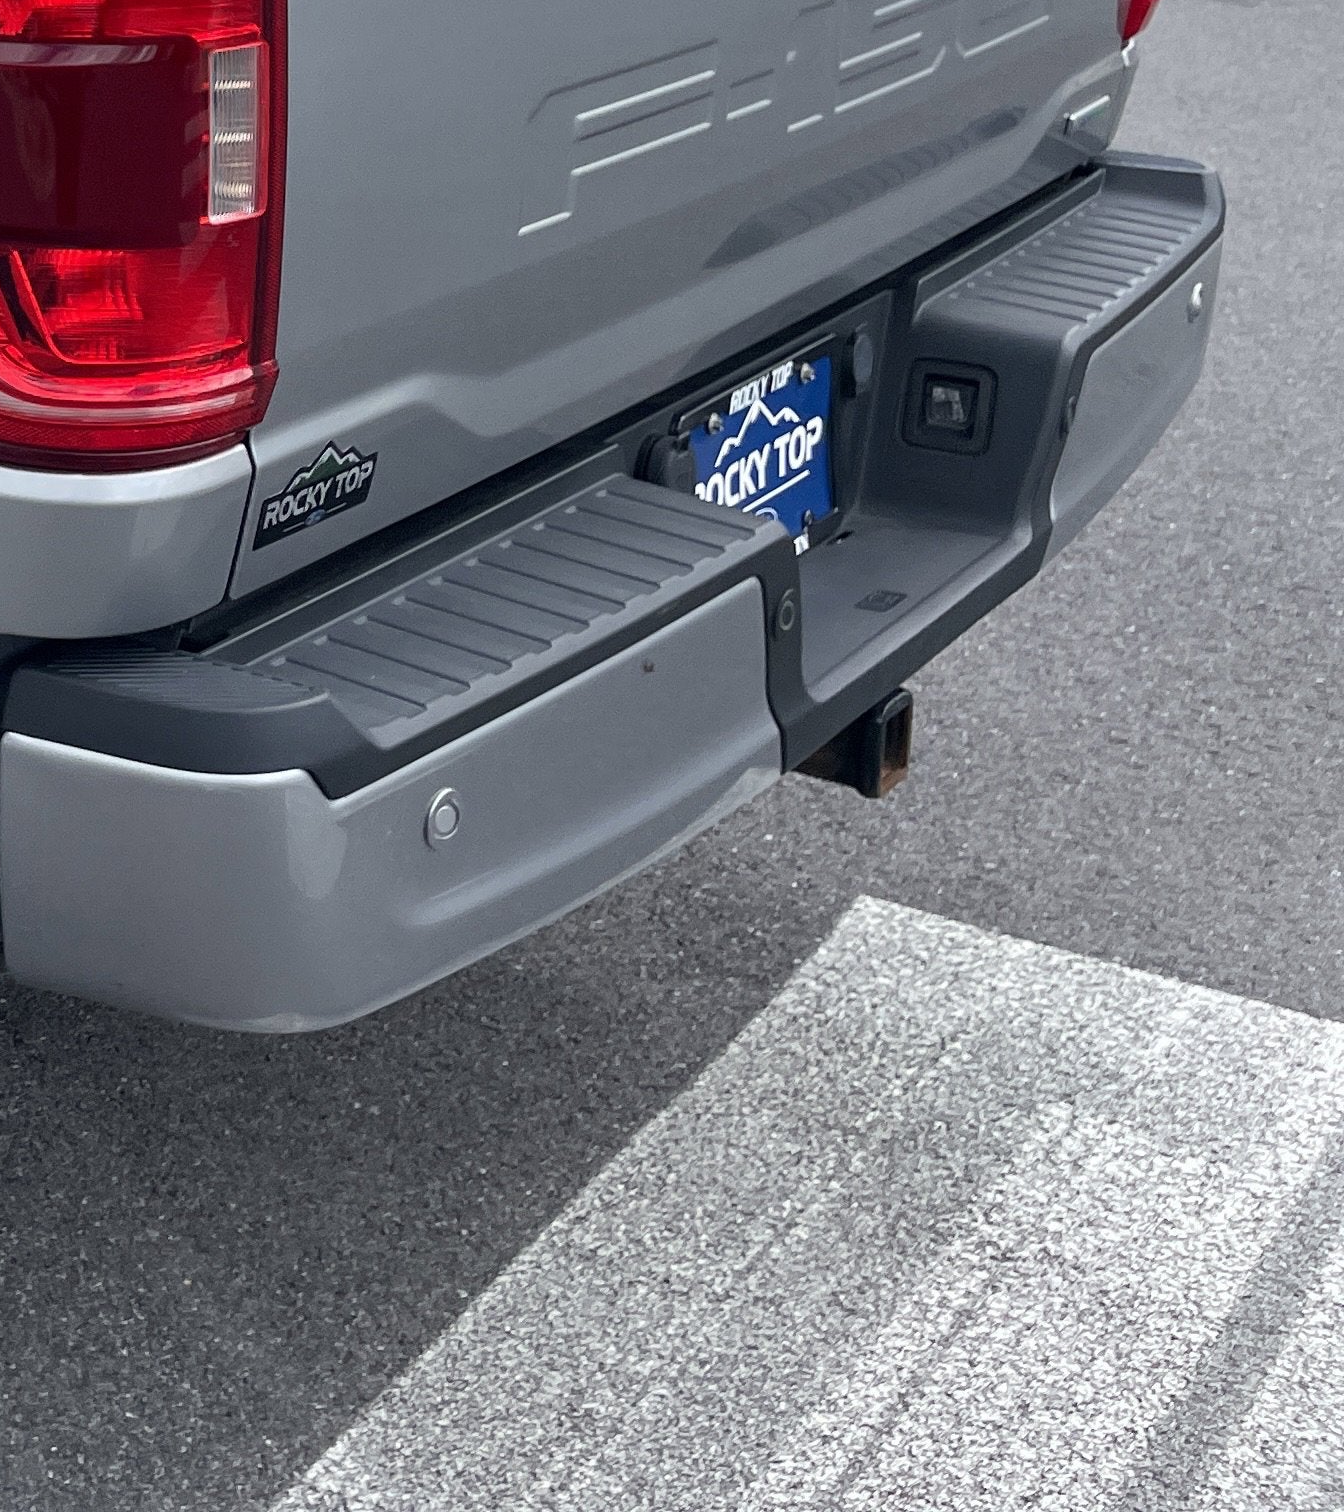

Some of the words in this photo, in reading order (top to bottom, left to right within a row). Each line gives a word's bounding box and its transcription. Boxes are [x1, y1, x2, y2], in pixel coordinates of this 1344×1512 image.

[729, 373, 770, 415] ROCKY
[771, 361, 794, 392] TOP
[774, 416, 823, 477] TOP
[262, 477, 334, 530] ROCKY
[336, 460, 373, 498] TOP
